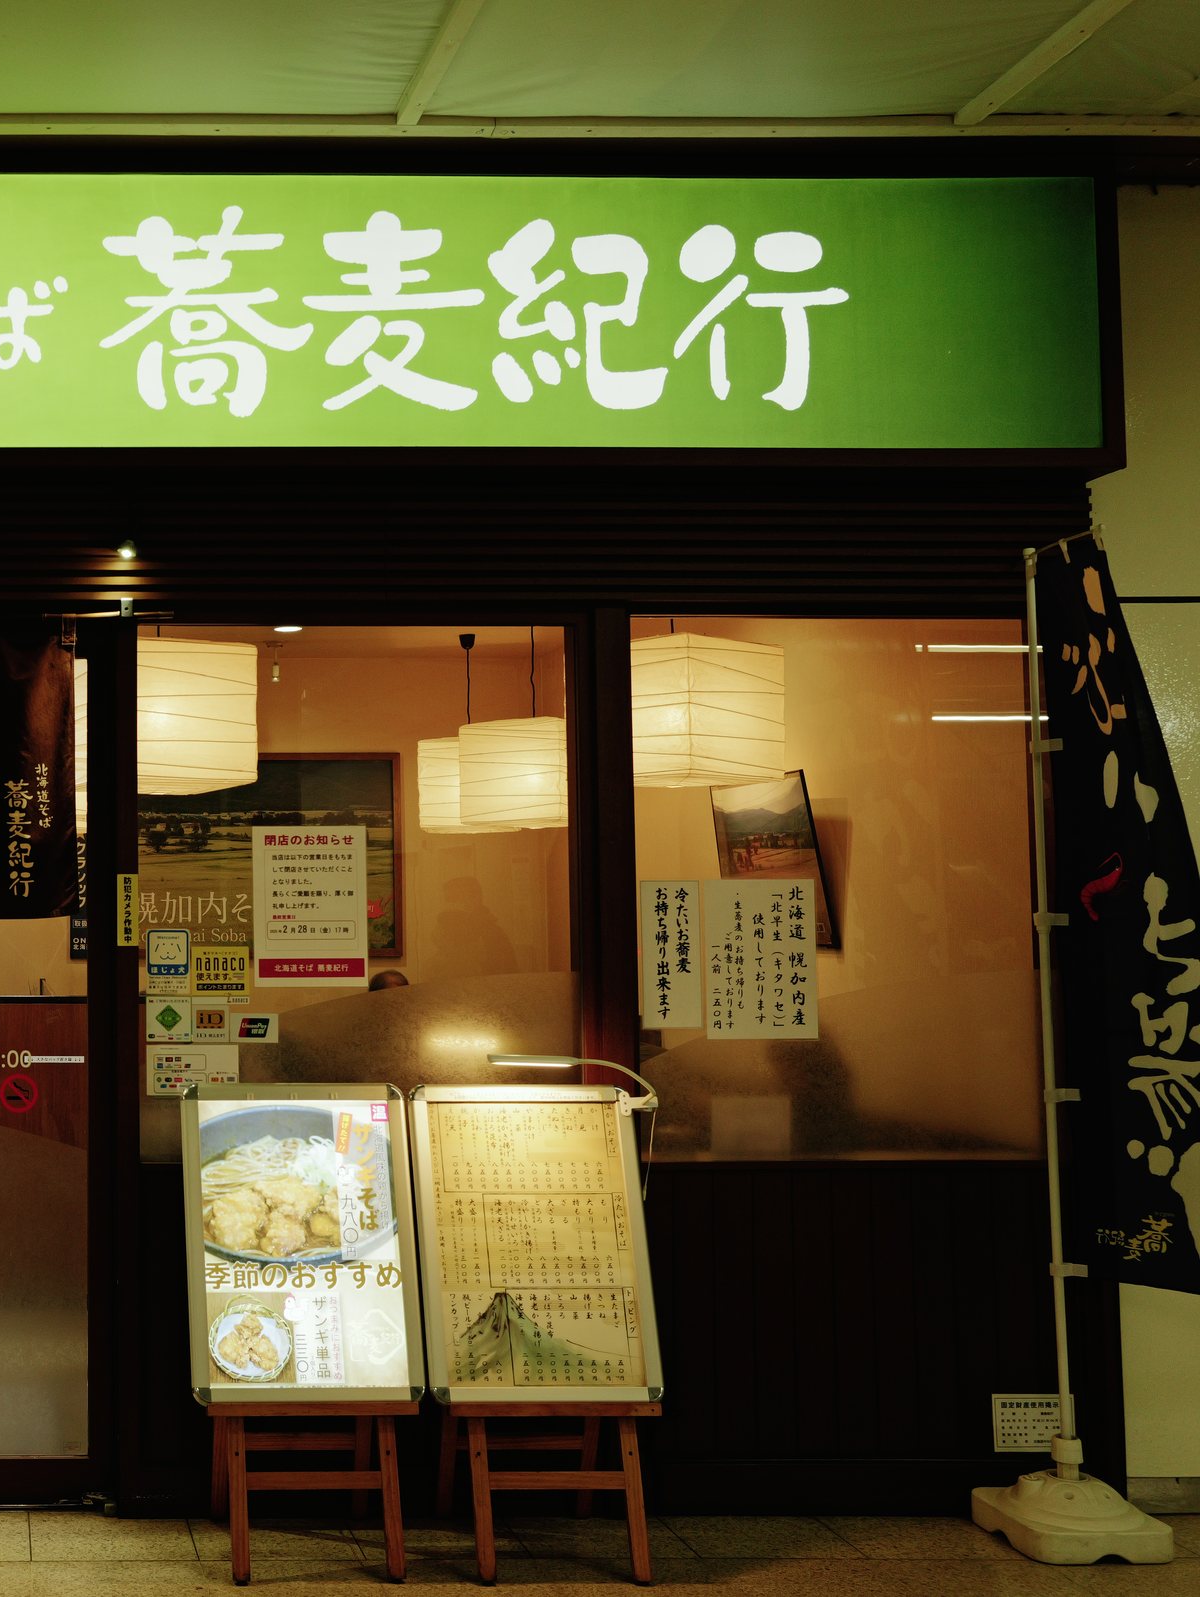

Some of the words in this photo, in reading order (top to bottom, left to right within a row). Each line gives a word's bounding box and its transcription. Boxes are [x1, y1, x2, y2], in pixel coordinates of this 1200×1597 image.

[99, 205, 850, 418] 蕎麦紀行
[34, 763, 54, 829] 北海道そば
[4, 779, 35, 898] 蕎麦紀行
[264, 834, 354, 846] 閉店のお知らせ
[123, 877, 133, 943] 防犯カメラ作動中
[211, 928, 247, 942] Soba
[674, 887, 691, 974] 冷たいお蕎麦
[788, 886, 806, 940] 北海道
[151, 966, 186, 974] ほじょ犬
[196, 957, 245, 971] nanaco
[196, 973, 232, 981] 使えます。
[274, 963, 314, 972] 北海道そば
[317, 963, 349, 972] 蕎麦紀行
[654, 887, 671, 1020] お持ち帰り出来ます
[711, 945, 722, 974] 一人前
[724, 931, 735, 1030] ご用意しております
[753, 913, 766, 1024] 使用しております
[788, 952, 807, 1026] 幌加内産
[200, 1012, 223, 1025] iD
[353, 1123, 379, 1231] ザンギそば
[454, 1199, 464, 1224] 特盛り
[468, 1199, 477, 1224] 大盛り
[572, 1199, 581, 1223] 特もり
[534, 1199, 542, 1223] とろろ
[539, 1255, 548, 1284] 八五〇円
[547, 1199, 555, 1223] 大ざる
[552, 1255, 561, 1284] 八五〇円
[560, 1199, 568, 1223] ざる
[566, 1255, 575, 1284] 七〇〇円
[586, 1199, 595, 1223] 大もり
[592, 1255, 601, 1284] 八〇〇円
[599, 1199, 608, 1223] もり
[605, 1255, 615, 1284] 六五〇円
[205, 1261, 402, 1290] 季節のおすすめ
[449, 1293, 458, 1329] ワンカップ
[514, 1293, 524, 1319] 海老天
[529, 1293, 542, 1347] 海老かき揚げ
[543, 1293, 554, 1338] おぼろ昆布
[557, 1293, 565, 1319] とろろ
[569, 1293, 579, 1319] 山菜
[625, 1289, 635, 1333] トッピング
[312, 1296, 331, 1379] ザンギ単品
[582, 1293, 593, 1319] 揚げ玉
[590, 1359, 598, 1381] 五〇円
[596, 1293, 605, 1318] きつね
[603, 1359, 611, 1381] 五〇円
[609, 1293, 619, 1328] 生たまご
[617, 1359, 625, 1381] 五〇円
